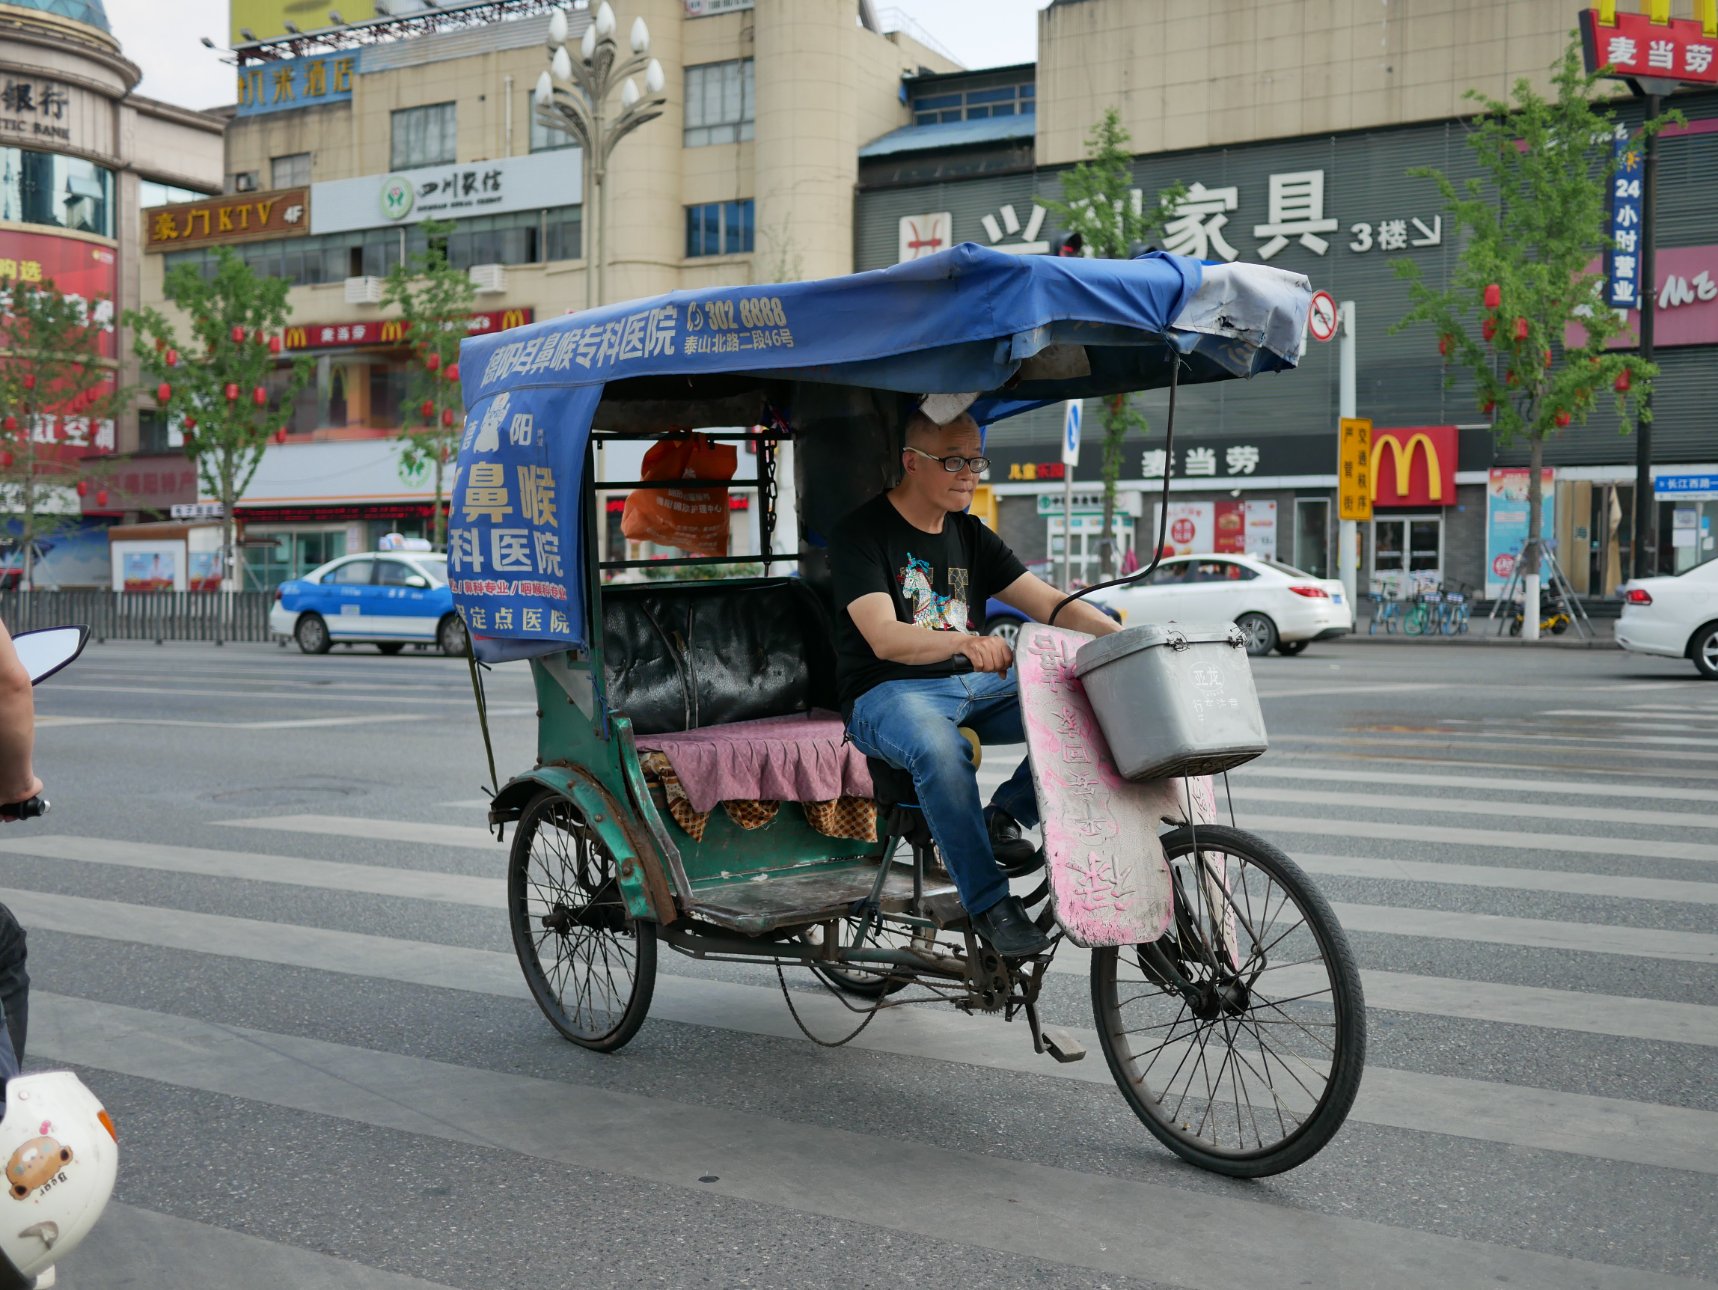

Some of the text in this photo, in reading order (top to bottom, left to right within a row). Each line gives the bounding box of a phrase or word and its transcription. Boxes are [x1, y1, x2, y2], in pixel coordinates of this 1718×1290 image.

[1607, 36, 1713, 73] 麦当劳
[1350, 219, 1407, 252] 3楼
[705, 297, 787, 330] 302 8888
[684, 328, 794, 355] 泰山北路二段46号
[1141, 446, 1260, 478] 麦当劳
[449, 461, 558, 528] 鼻喉
[450, 527, 564, 578] 科医院
